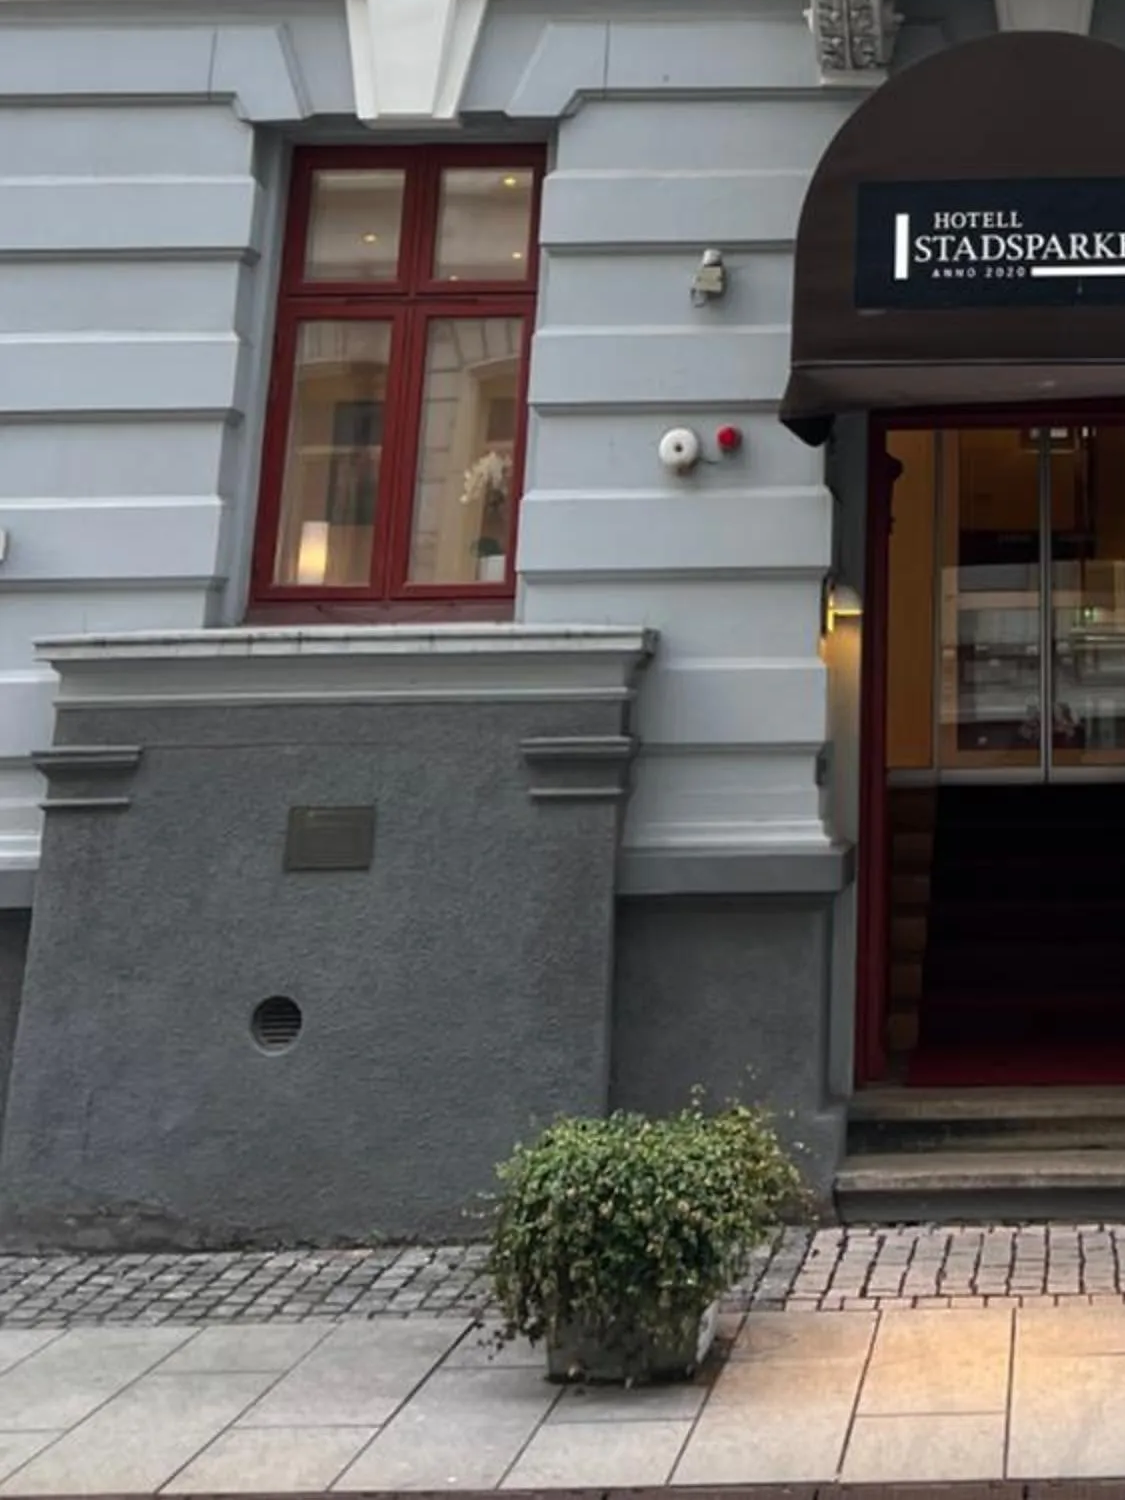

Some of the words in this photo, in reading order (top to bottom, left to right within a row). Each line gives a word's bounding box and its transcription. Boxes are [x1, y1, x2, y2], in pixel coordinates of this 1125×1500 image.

[934, 211, 1022, 229] HOTELL
[931, 267, 977, 279] ANNO
[986, 266, 1027, 279] 2020
